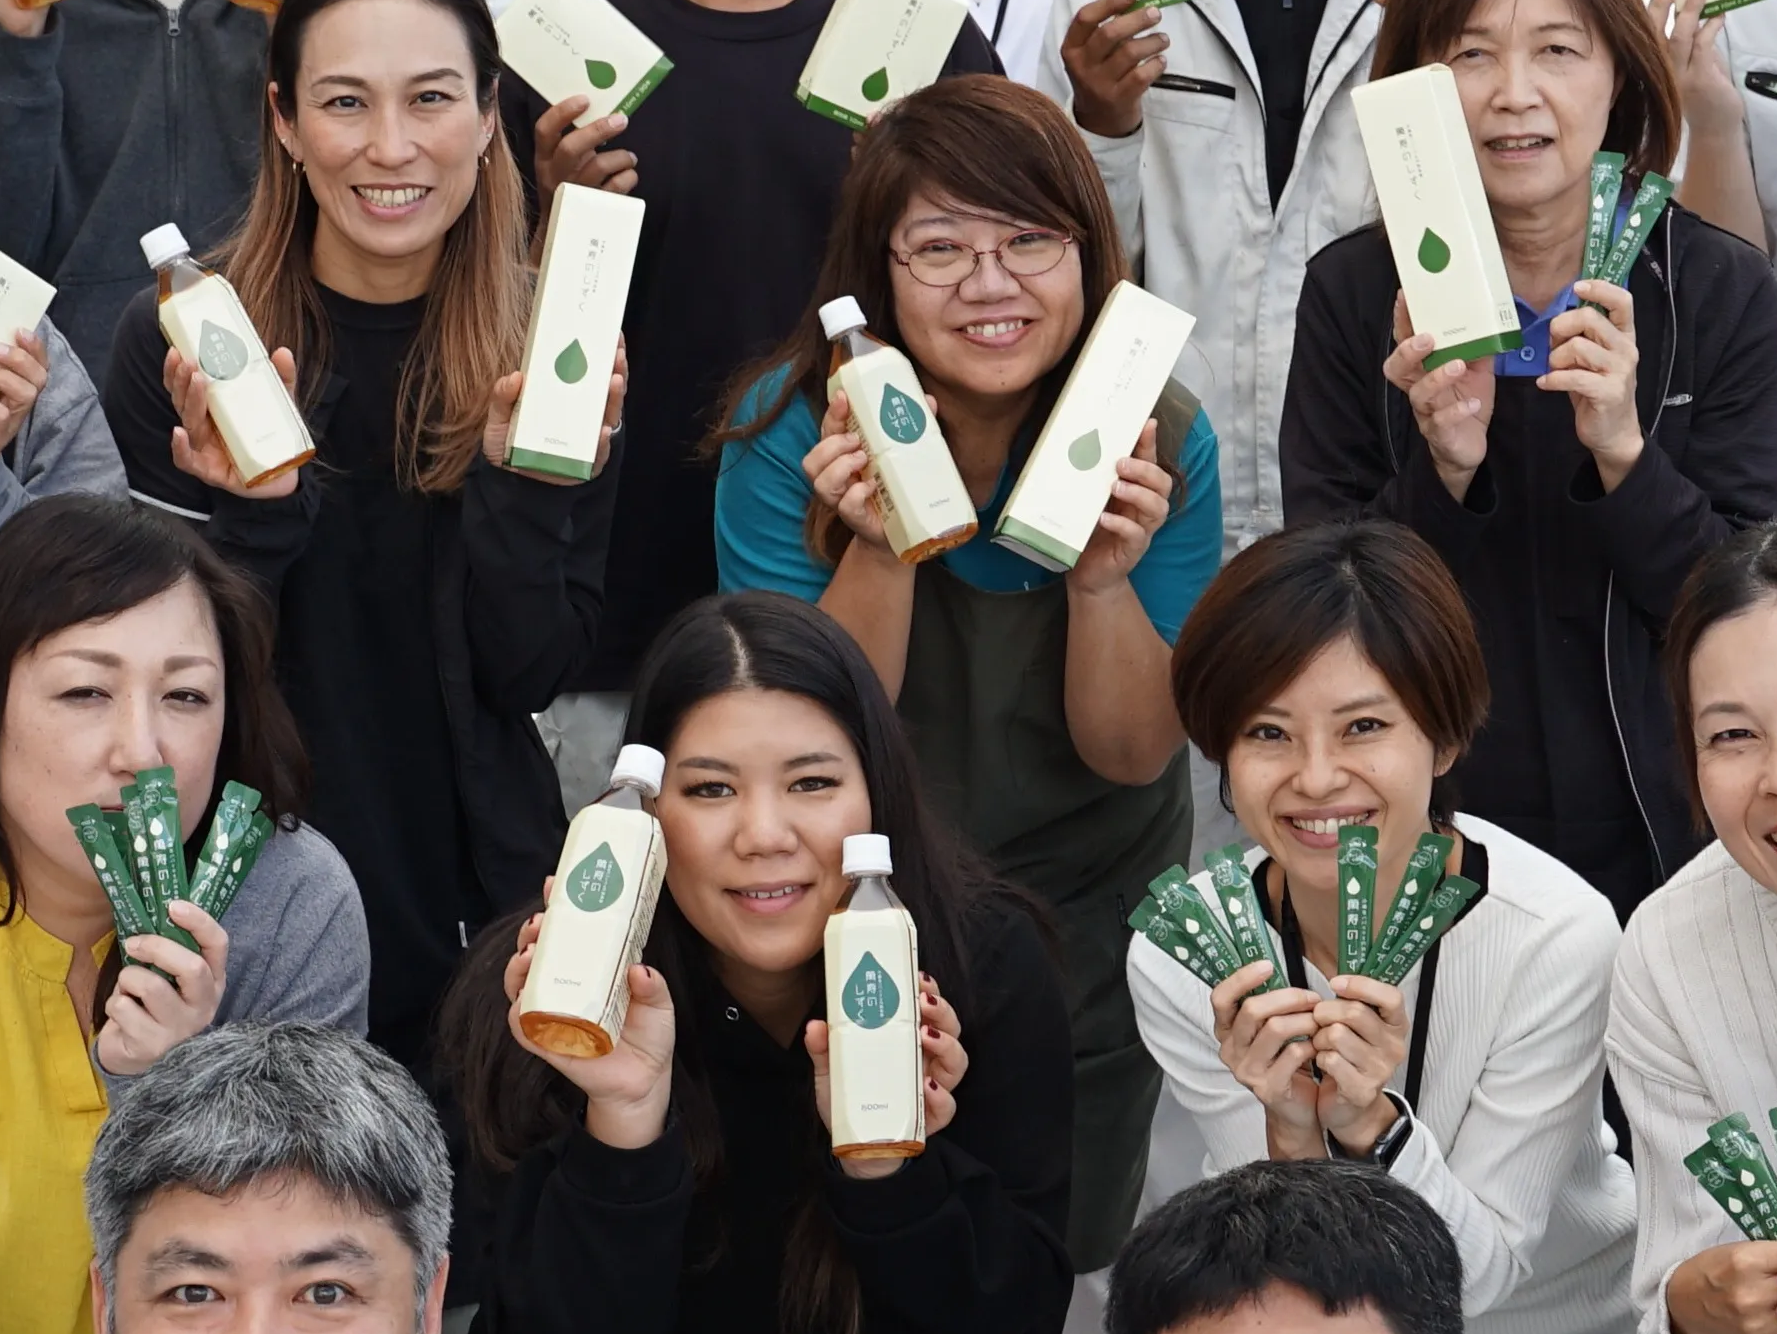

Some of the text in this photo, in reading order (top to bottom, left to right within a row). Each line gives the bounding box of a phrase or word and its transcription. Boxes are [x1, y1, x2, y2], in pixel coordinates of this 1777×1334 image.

[578, 869, 590, 903] しずく
[1196, 933, 1229, 975] 萬寿の
[854, 984, 866, 1022] しずく
